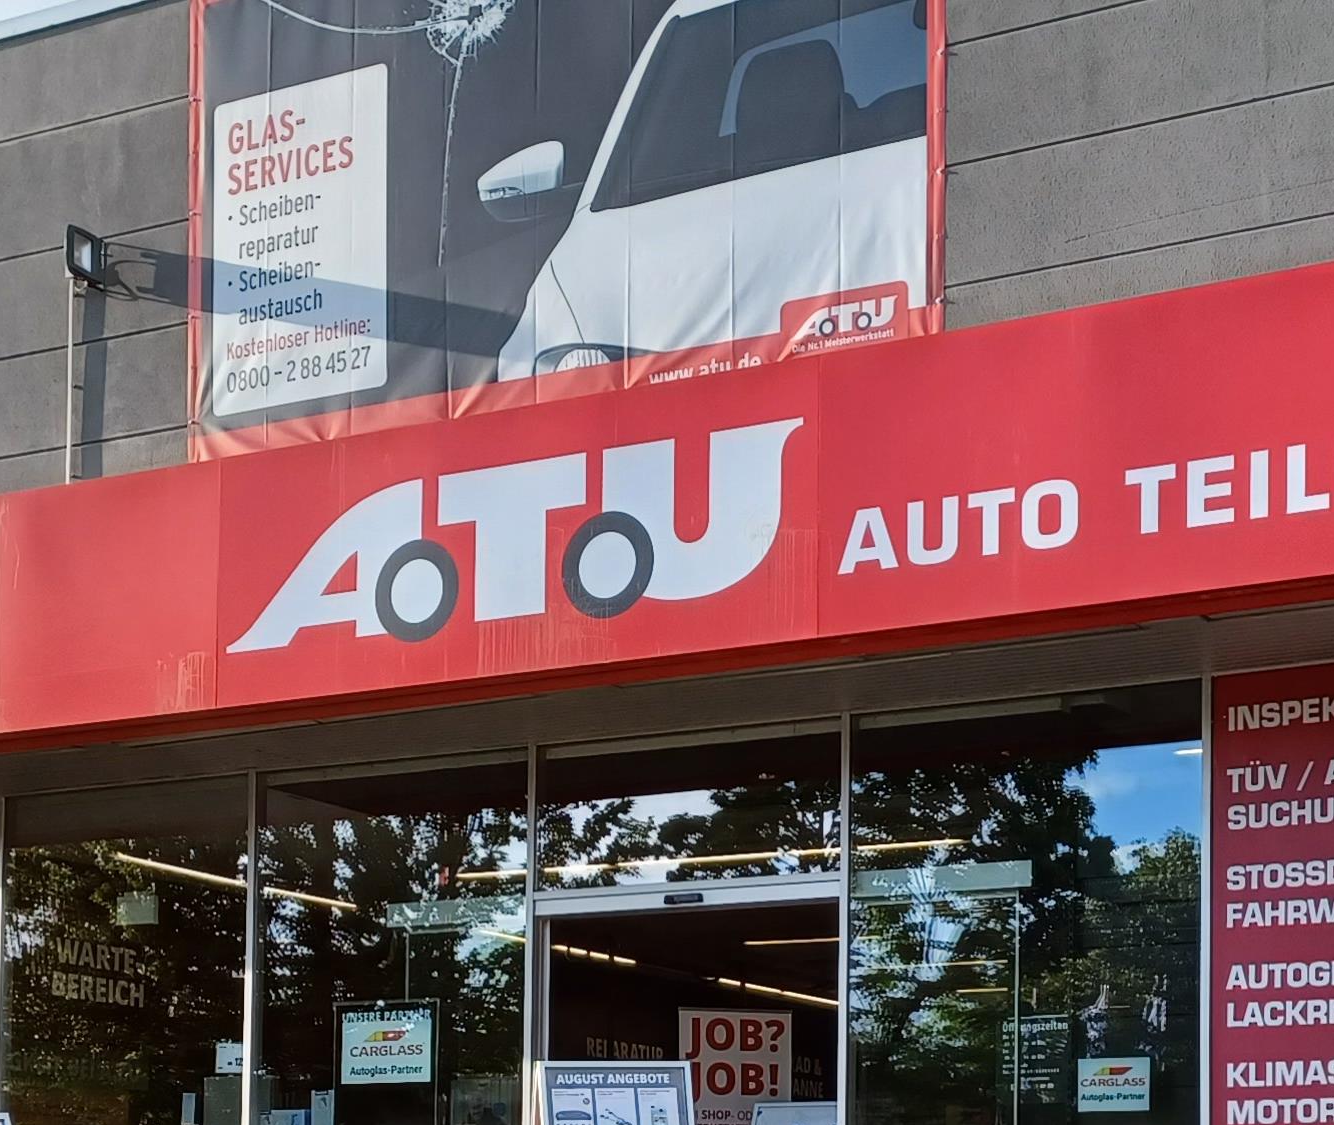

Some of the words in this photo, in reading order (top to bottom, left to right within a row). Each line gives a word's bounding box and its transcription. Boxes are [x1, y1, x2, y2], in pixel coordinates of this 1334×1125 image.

[228, 109, 306, 154] GLAS-
[228, 135, 354, 195] SERVICES
[239, 193, 321, 226] Scheiben-
[239, 224, 319, 260] reparatur
[239, 259, 321, 292] Scheiben-
[238, 289, 322, 325] austausch
[790, 295, 898, 340] ATU
[227, 328, 308, 361] Kostenloser
[314, 318, 371, 345] Hotline:
[227, 365, 270, 393] 0800
[226, 417, 805, 652] ATU
[837, 478, 1080, 575] AUTO
[1227, 761, 1287, 792] TÜV
[1296, 761, 1314, 791] /
[51, 970, 145, 1008] BEREICH
[342, 1012, 381, 1023] UNSERE
[350, 1044, 424, 1058] CARGLASS
[686, 1017, 785, 1059] JOB?
[350, 1065, 424, 1078] Autoglas-Partner
[556, 1073, 604, 1085] AUGUST
[607, 1073, 670, 1085] ANGEBOTE
[693, 1062, 779, 1103] JOB!
[1080, 1078, 1146, 1087] CARGLASS
[1081, 1093, 1145, 1102] Autoglas-Partner
[701, 1109, 735, 1121] SHOP-
[737, 1110, 753, 1121] OD
